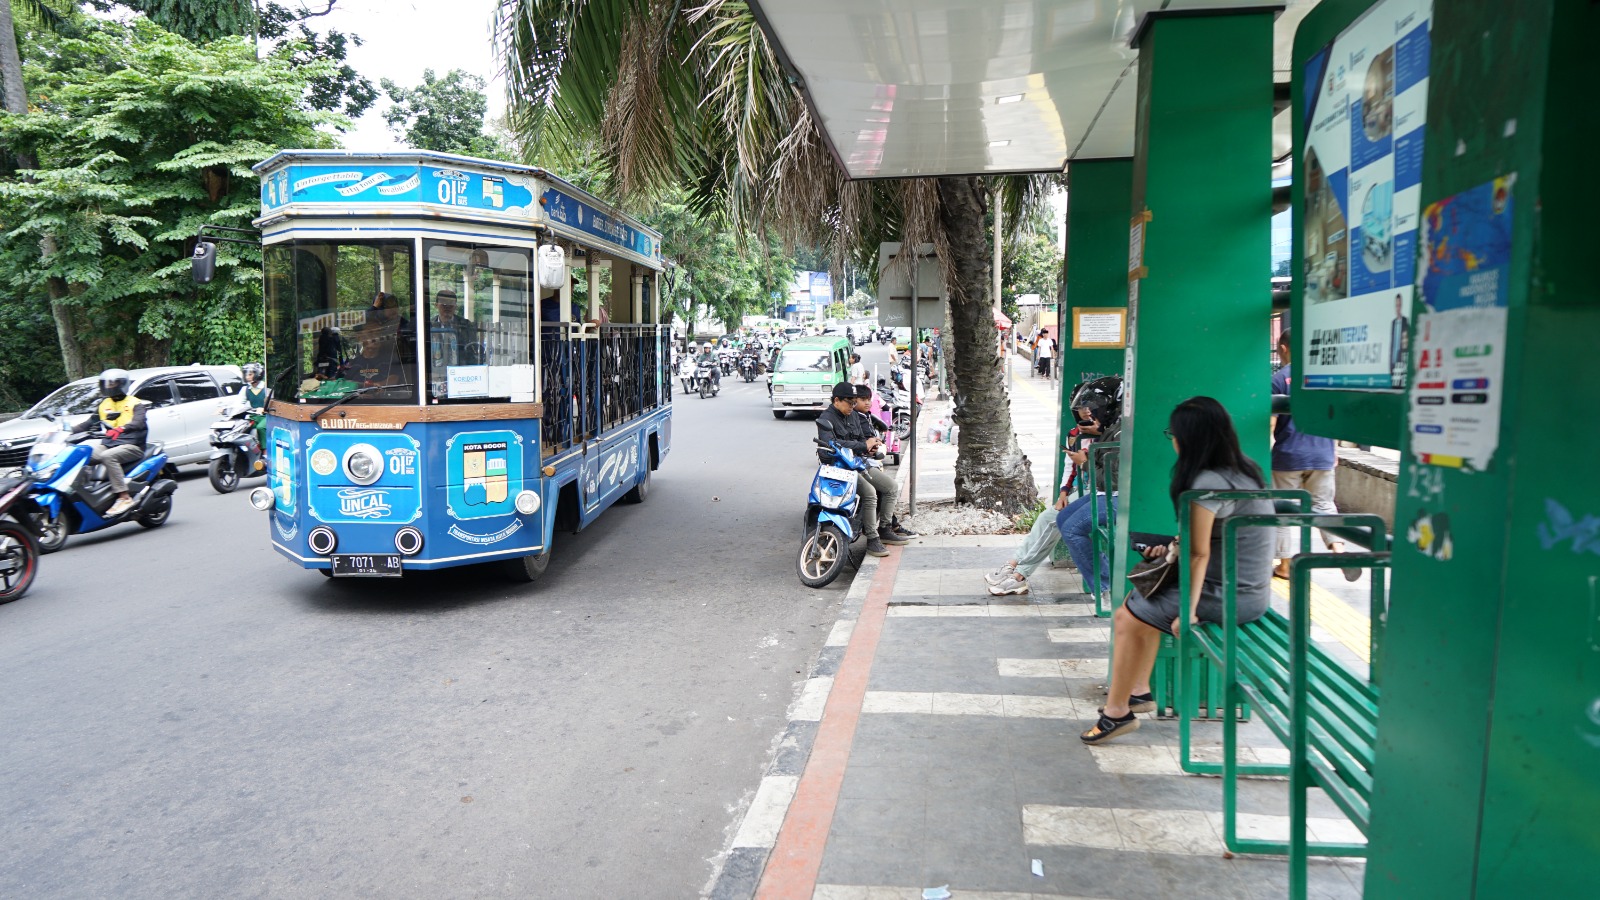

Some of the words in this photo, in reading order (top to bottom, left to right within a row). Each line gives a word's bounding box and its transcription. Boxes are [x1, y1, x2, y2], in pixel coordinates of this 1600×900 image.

[296, 173, 359, 188] Unforgettable
[341, 493, 388, 512] UNCAL
[333, 556, 341, 568] F
[349, 556, 374, 568] 7071
[387, 556, 400, 568] AB
